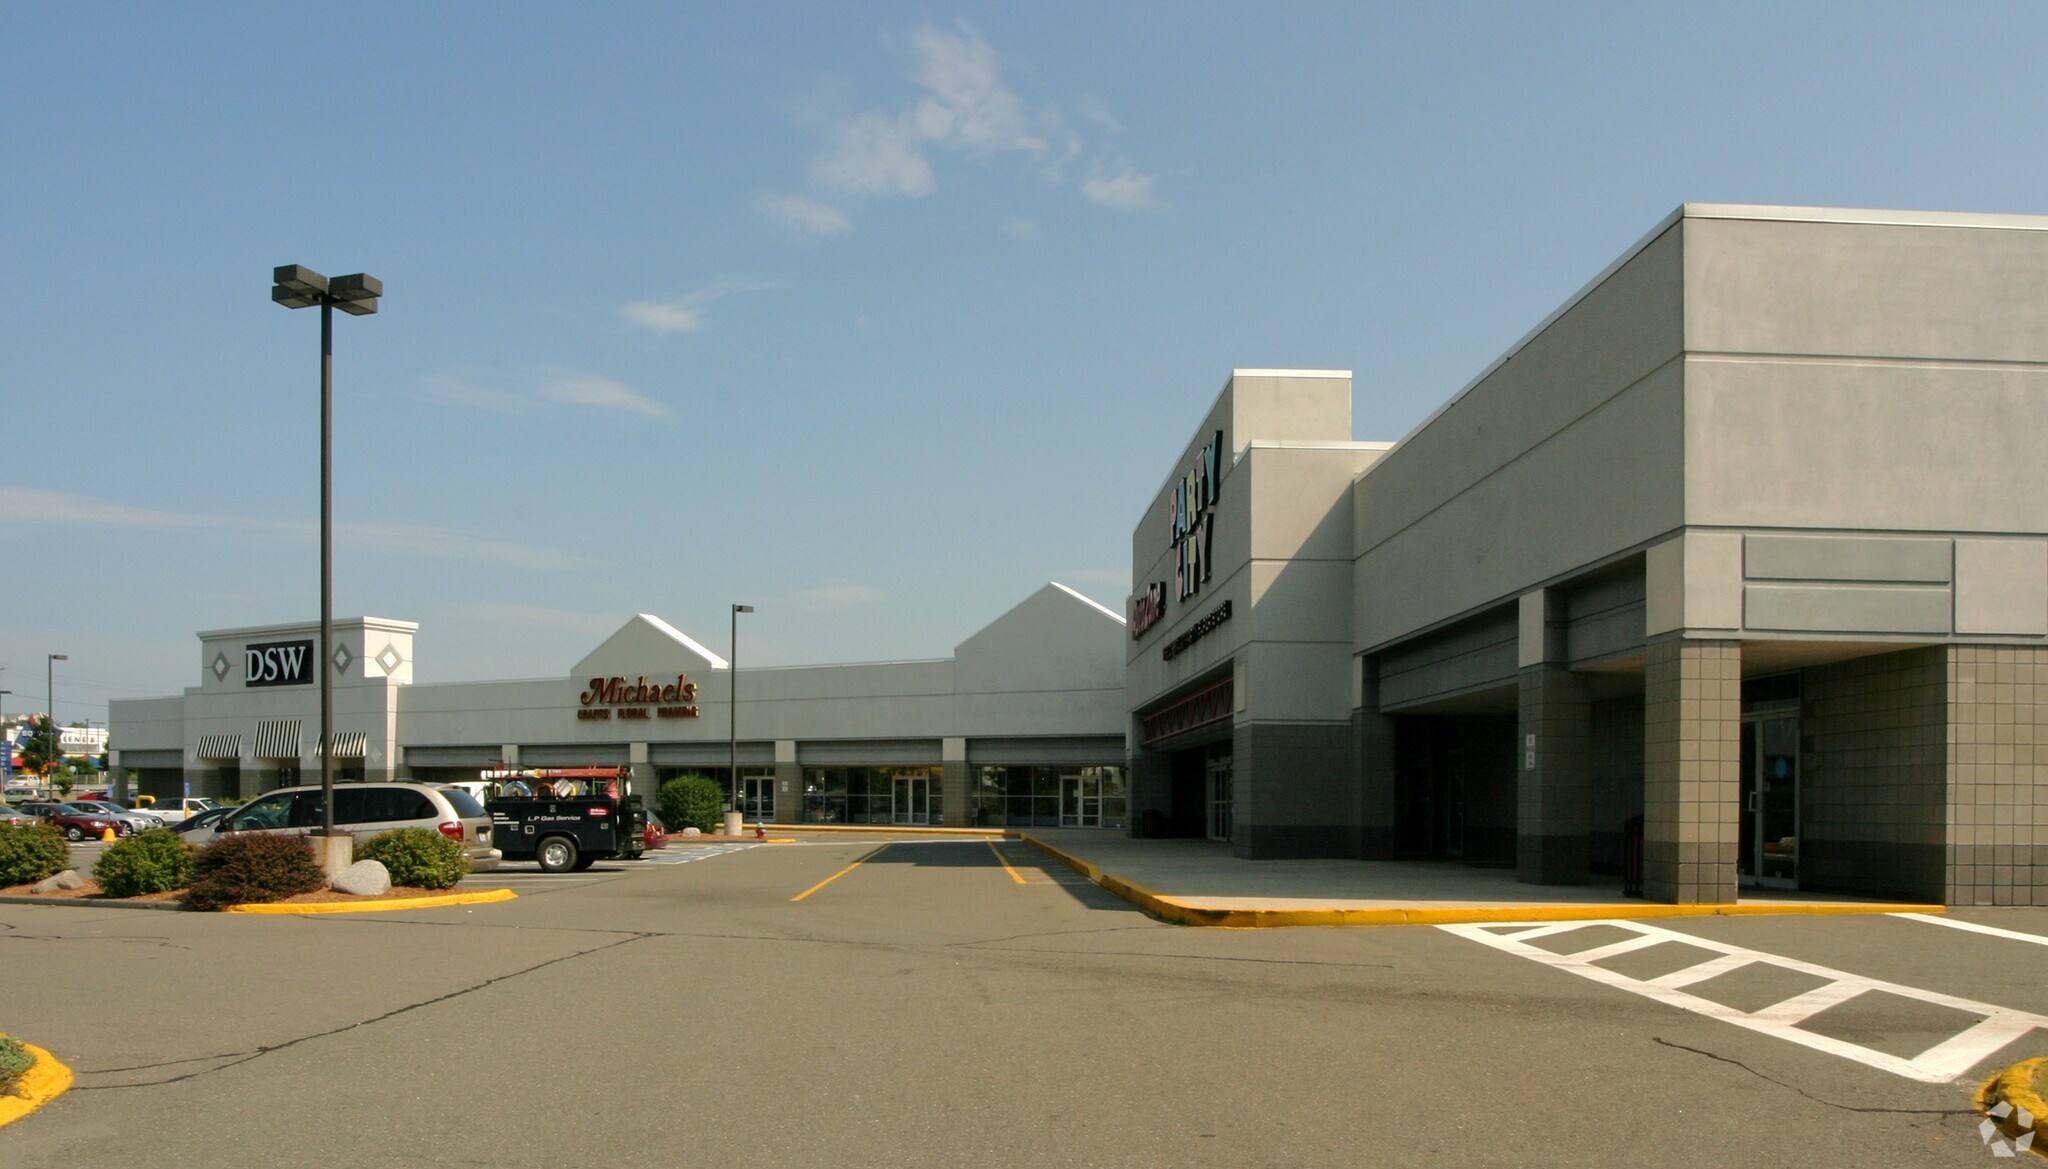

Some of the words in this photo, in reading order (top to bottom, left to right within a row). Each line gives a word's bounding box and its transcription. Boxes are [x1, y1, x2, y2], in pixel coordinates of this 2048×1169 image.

[1169, 430, 1223, 548] PARTY
[1174, 513, 1214, 603] CITY
[246, 646, 306, 682] DSW
[580, 673, 698, 705] Michaels
